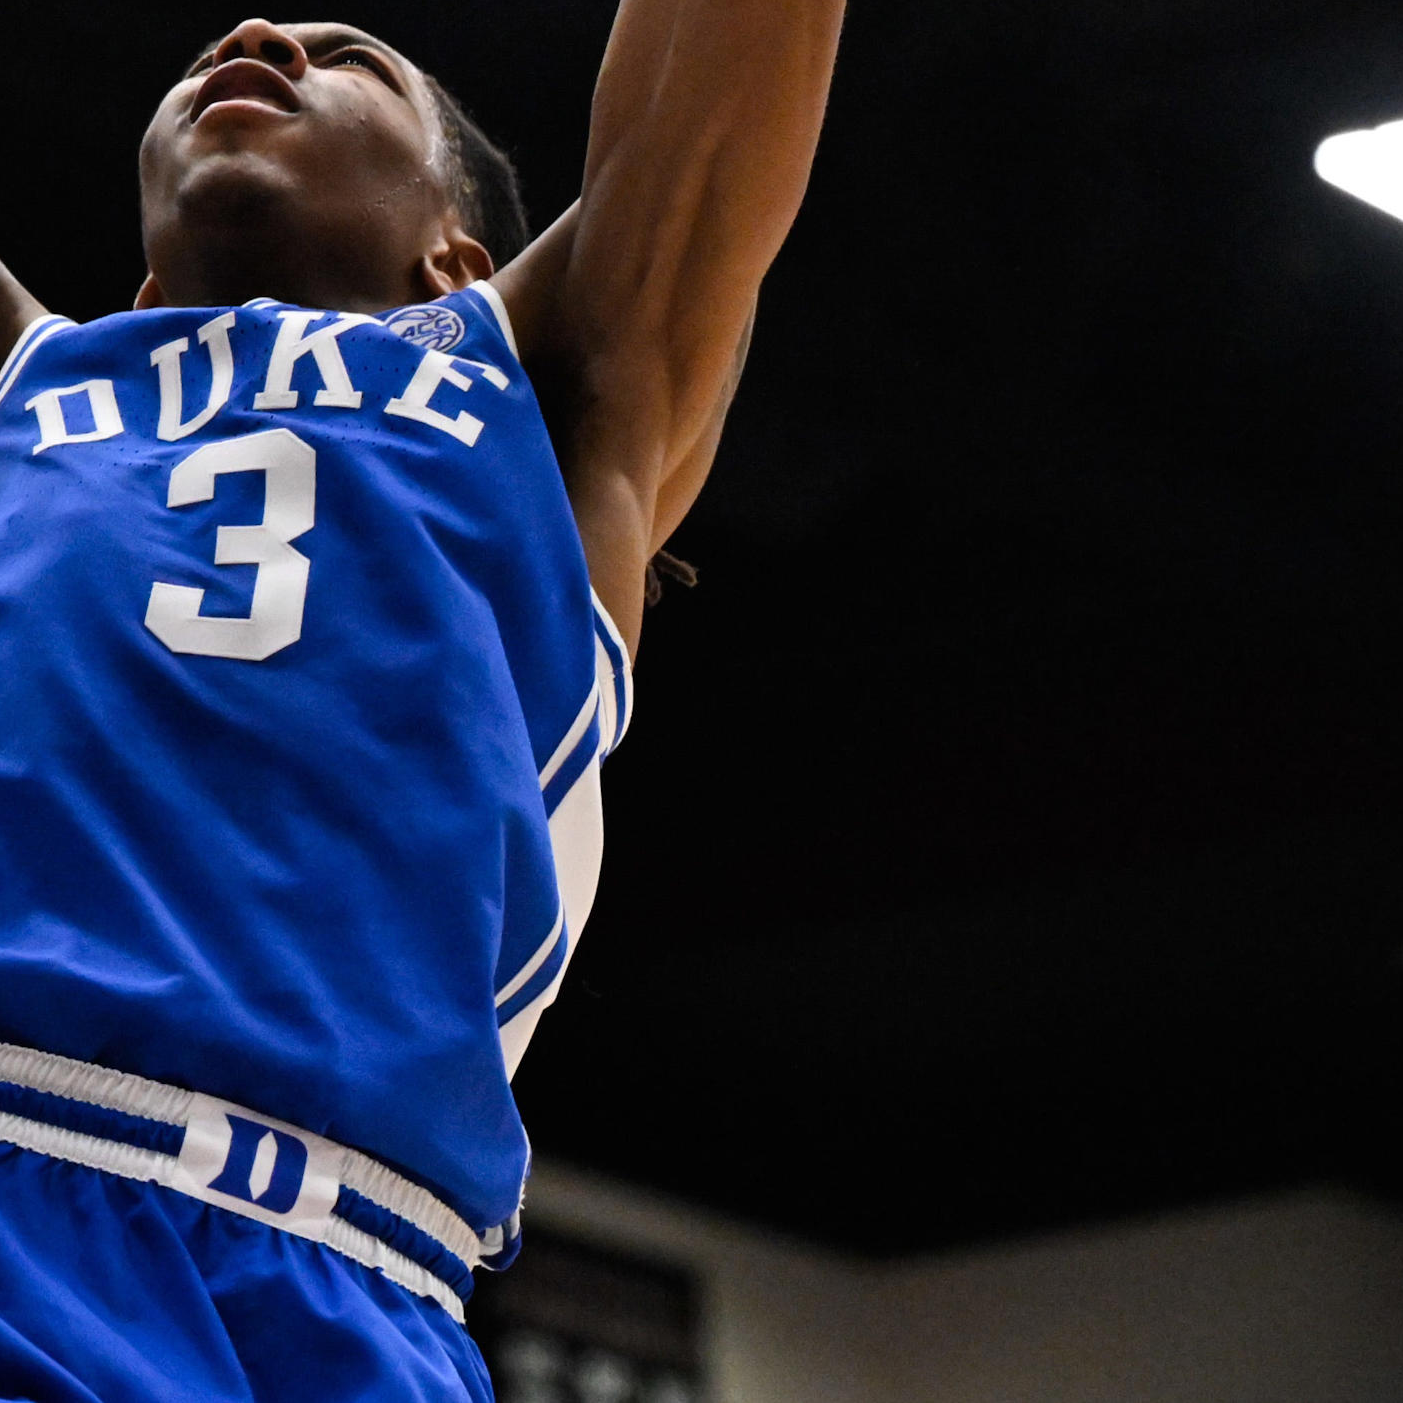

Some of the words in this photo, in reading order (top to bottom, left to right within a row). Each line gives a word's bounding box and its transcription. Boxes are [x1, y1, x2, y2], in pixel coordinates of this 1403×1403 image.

[25, 311, 510, 455] DUKE
[144, 428, 316, 661] 3
[207, 1113, 308, 1215] D
